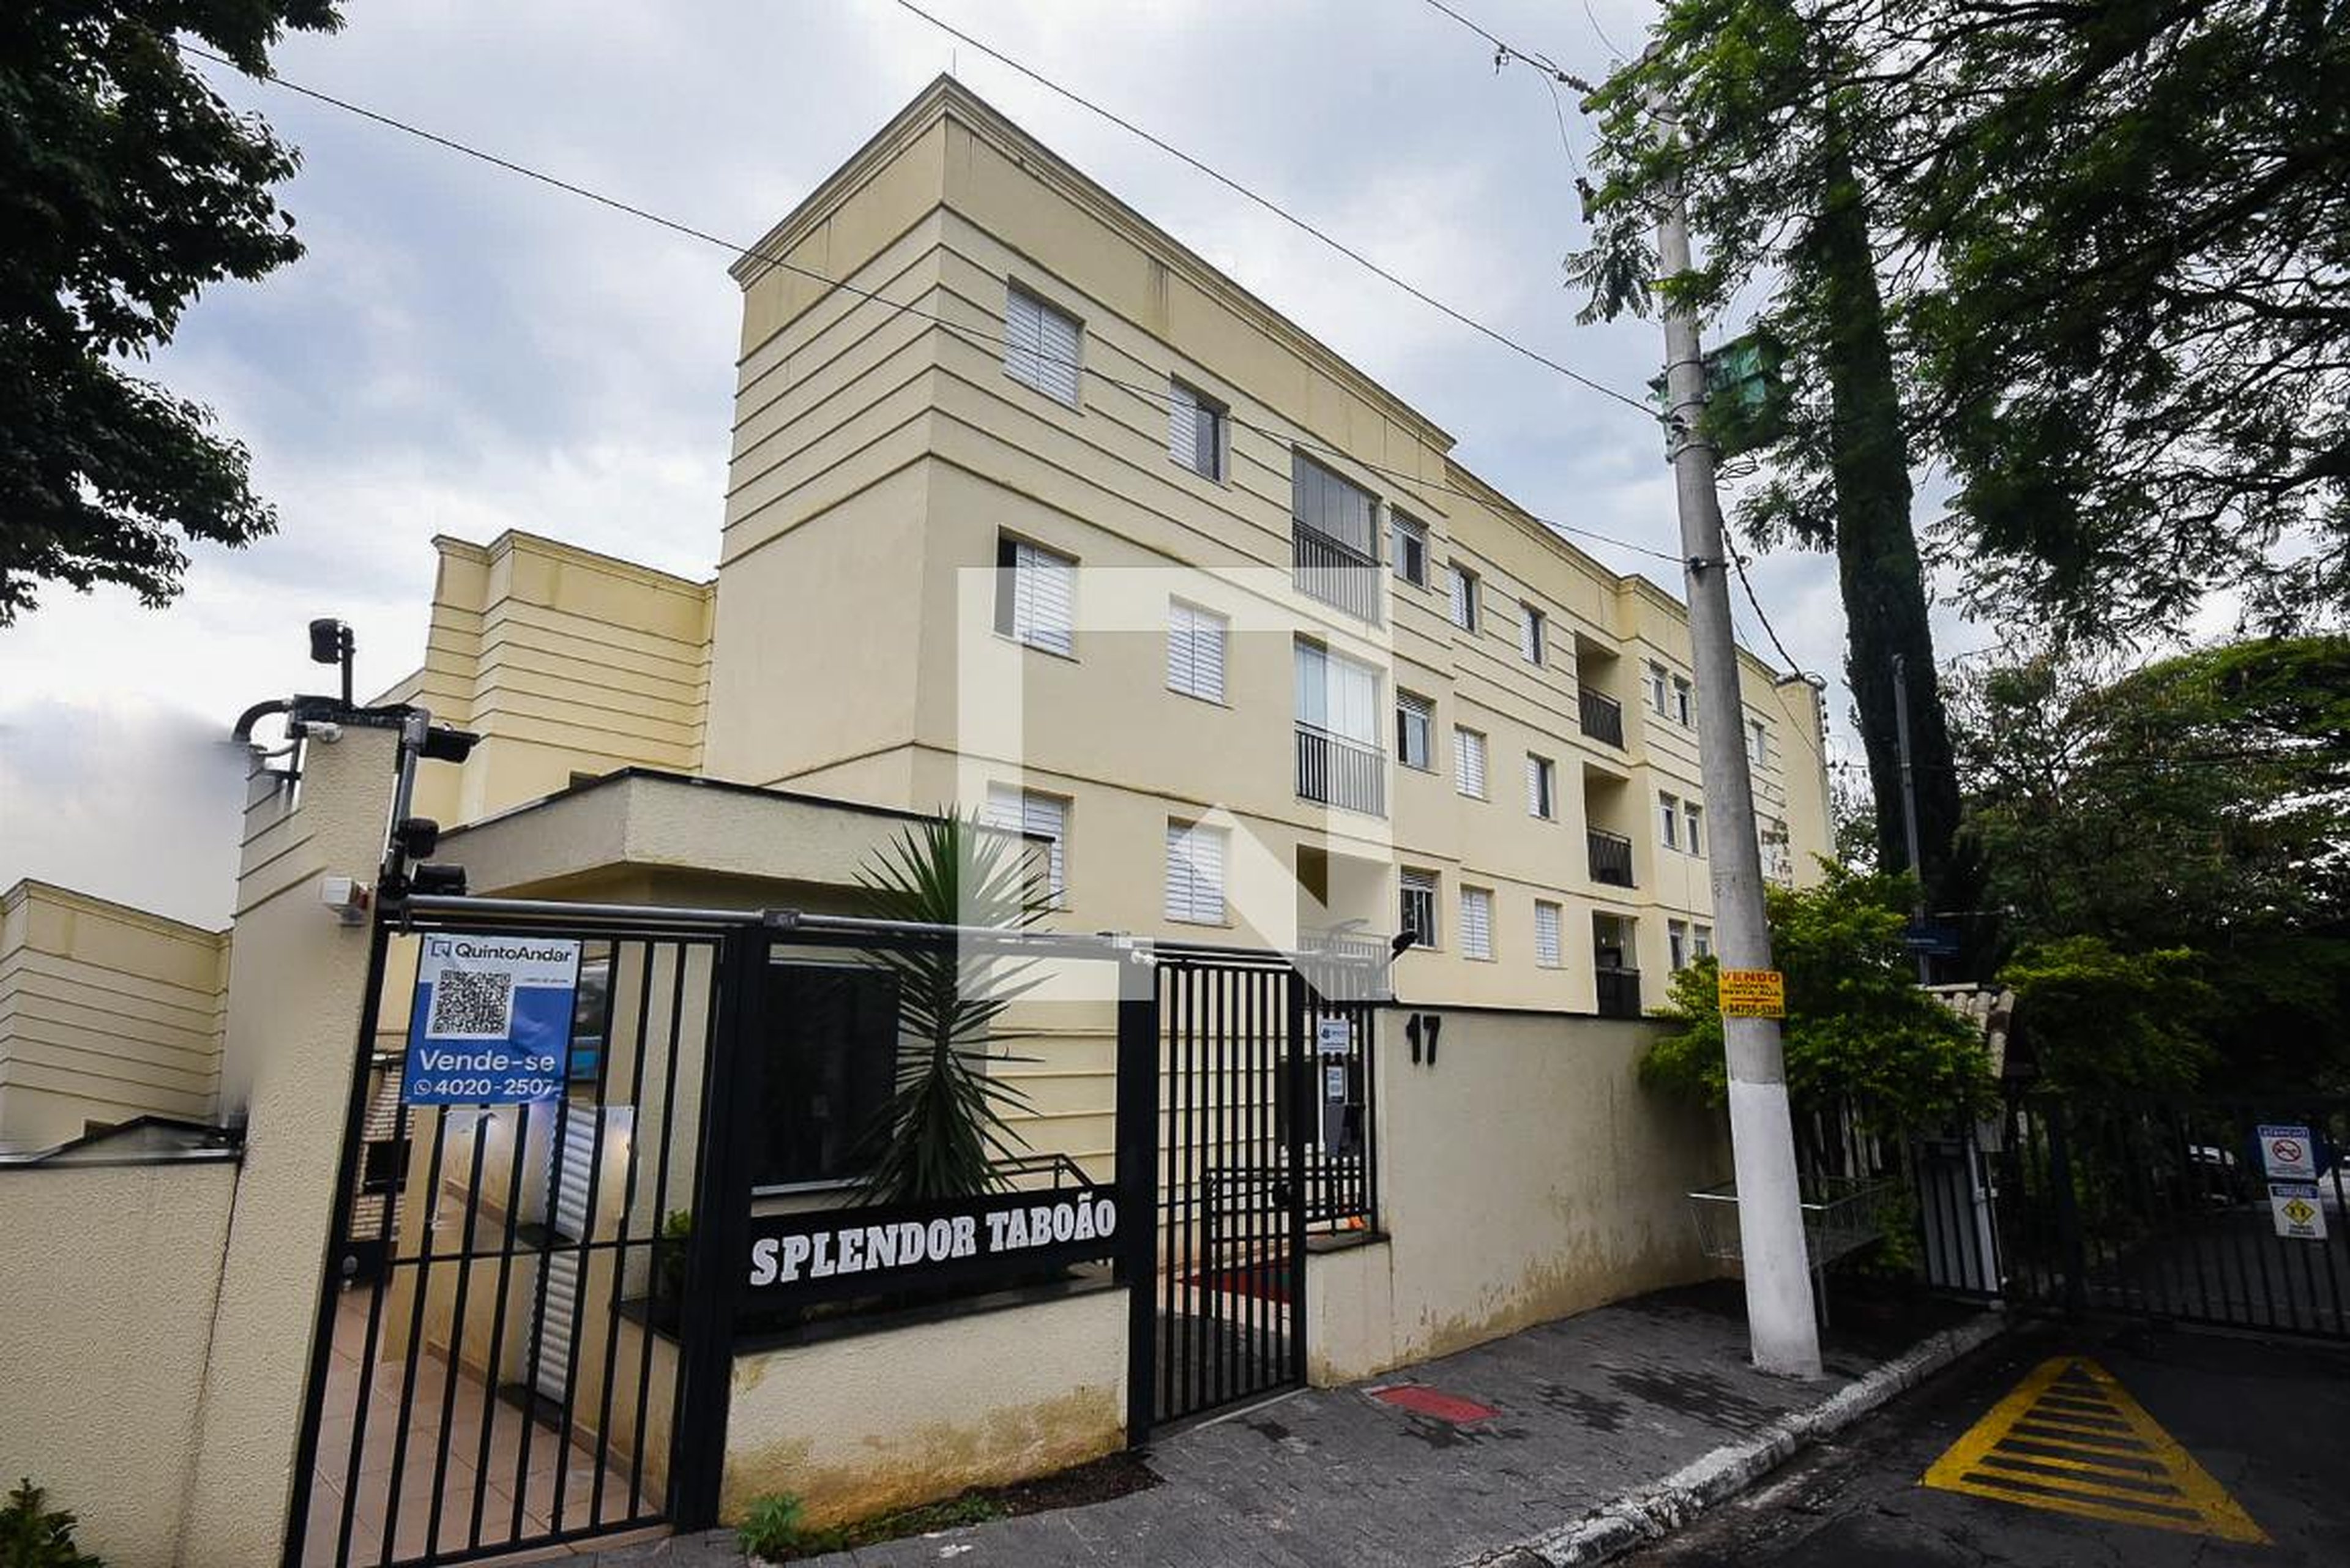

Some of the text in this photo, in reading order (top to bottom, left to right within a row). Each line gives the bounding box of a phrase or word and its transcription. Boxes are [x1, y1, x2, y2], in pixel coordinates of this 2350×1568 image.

[455, 943, 572, 962] QuintoAndar
[1721, 972, 1779, 982] VENDO
[1406, 1013, 1441, 1066] 17
[420, 1049, 556, 1071] Vende-se
[435, 1079, 554, 1096] 4020-2507
[750, 1192, 1116, 1286] SPLENDOR TABOÃO
